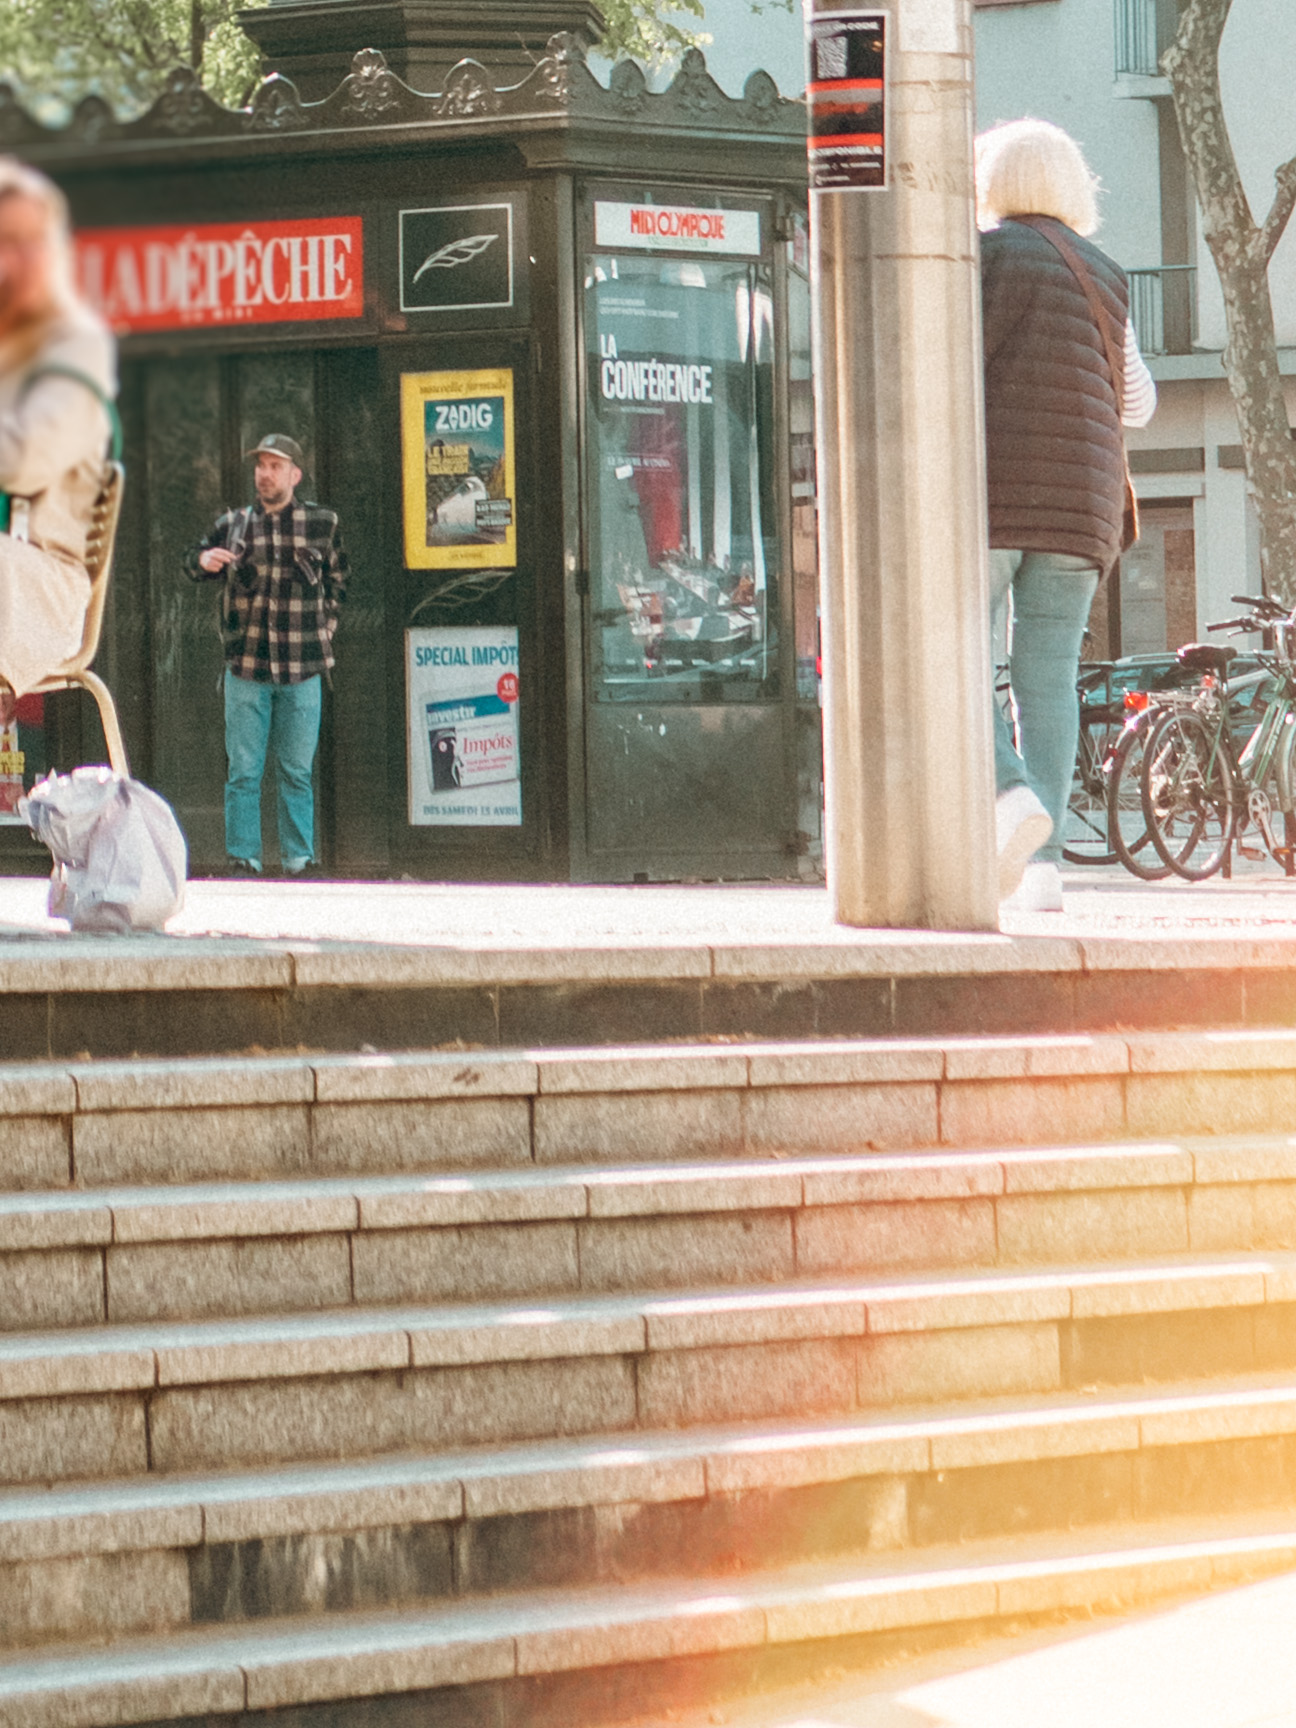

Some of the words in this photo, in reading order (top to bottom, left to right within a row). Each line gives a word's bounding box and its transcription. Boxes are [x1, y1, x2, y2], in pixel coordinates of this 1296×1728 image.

[630, 209, 656, 235] MIDI
[658, 211, 725, 239] OLYMPIQUE
[600, 334, 618, 359] LA
[601, 357, 713, 404] CONFÉRENCE
[435, 403, 493, 431] ZADIG
[463, 733, 513, 755] Impôts
